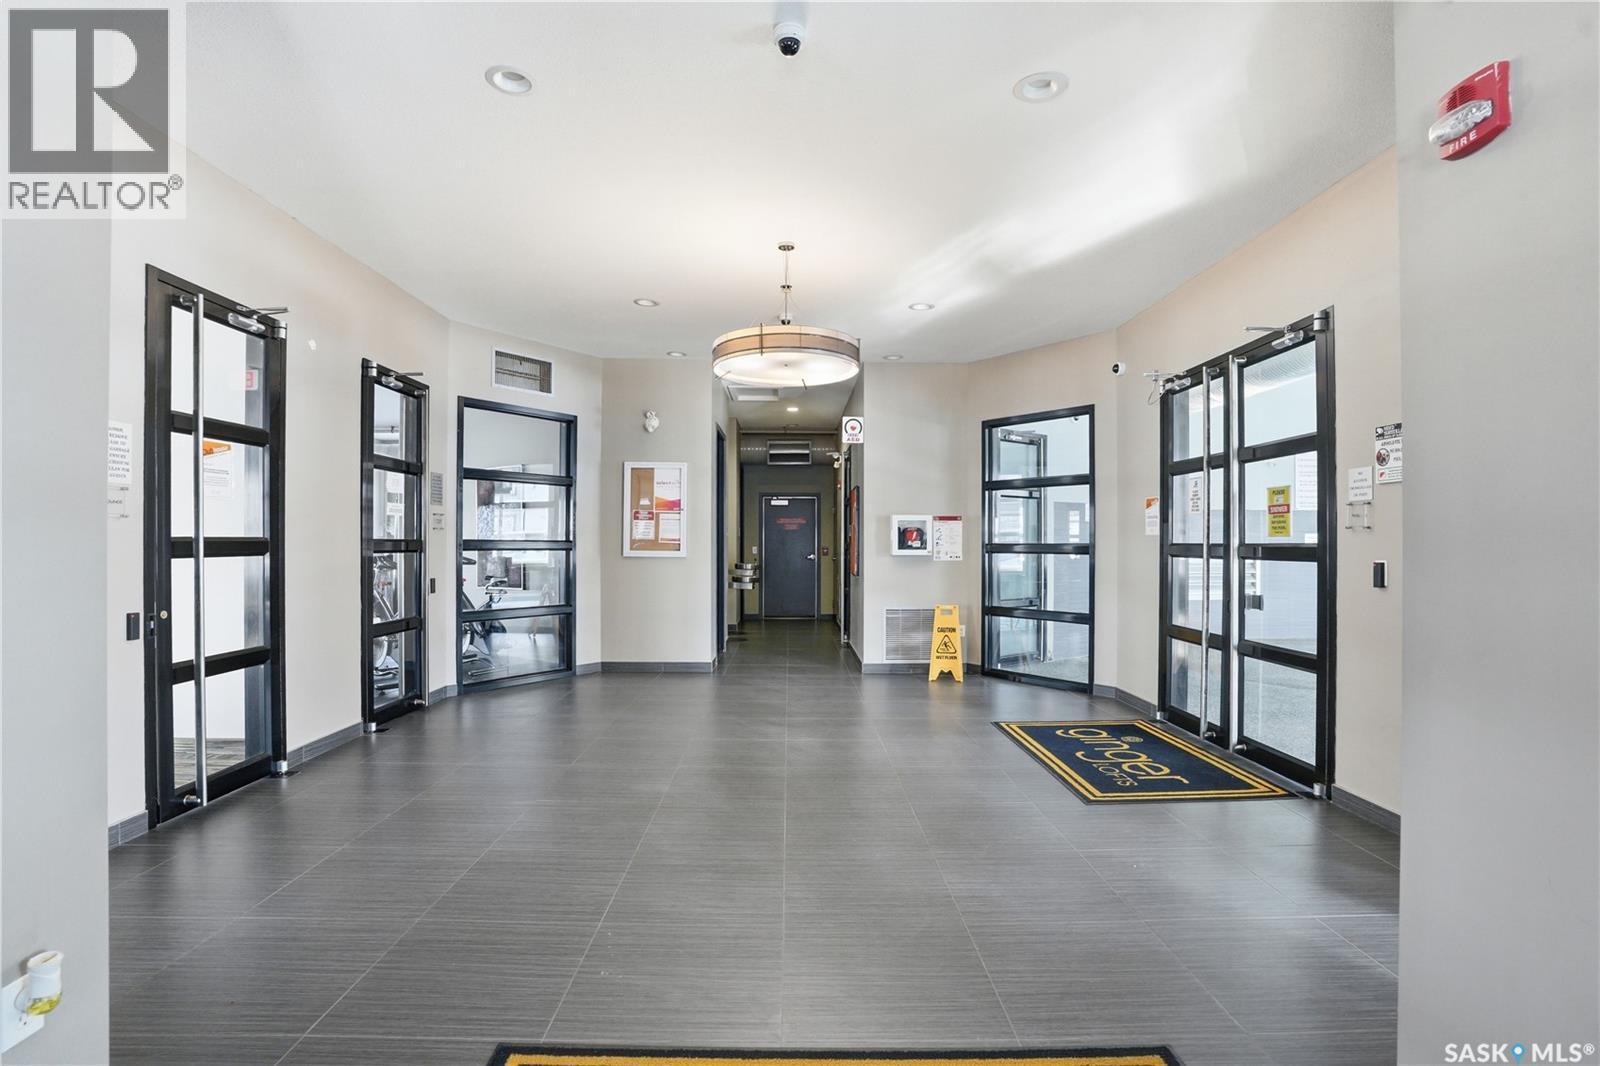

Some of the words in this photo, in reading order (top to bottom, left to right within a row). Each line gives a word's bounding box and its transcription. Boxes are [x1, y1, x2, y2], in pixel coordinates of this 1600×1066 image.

[1449, 130, 1477, 153] FIRE
[1056, 728, 1190, 784] ginger
[1092, 763, 1139, 786] LOFTS
